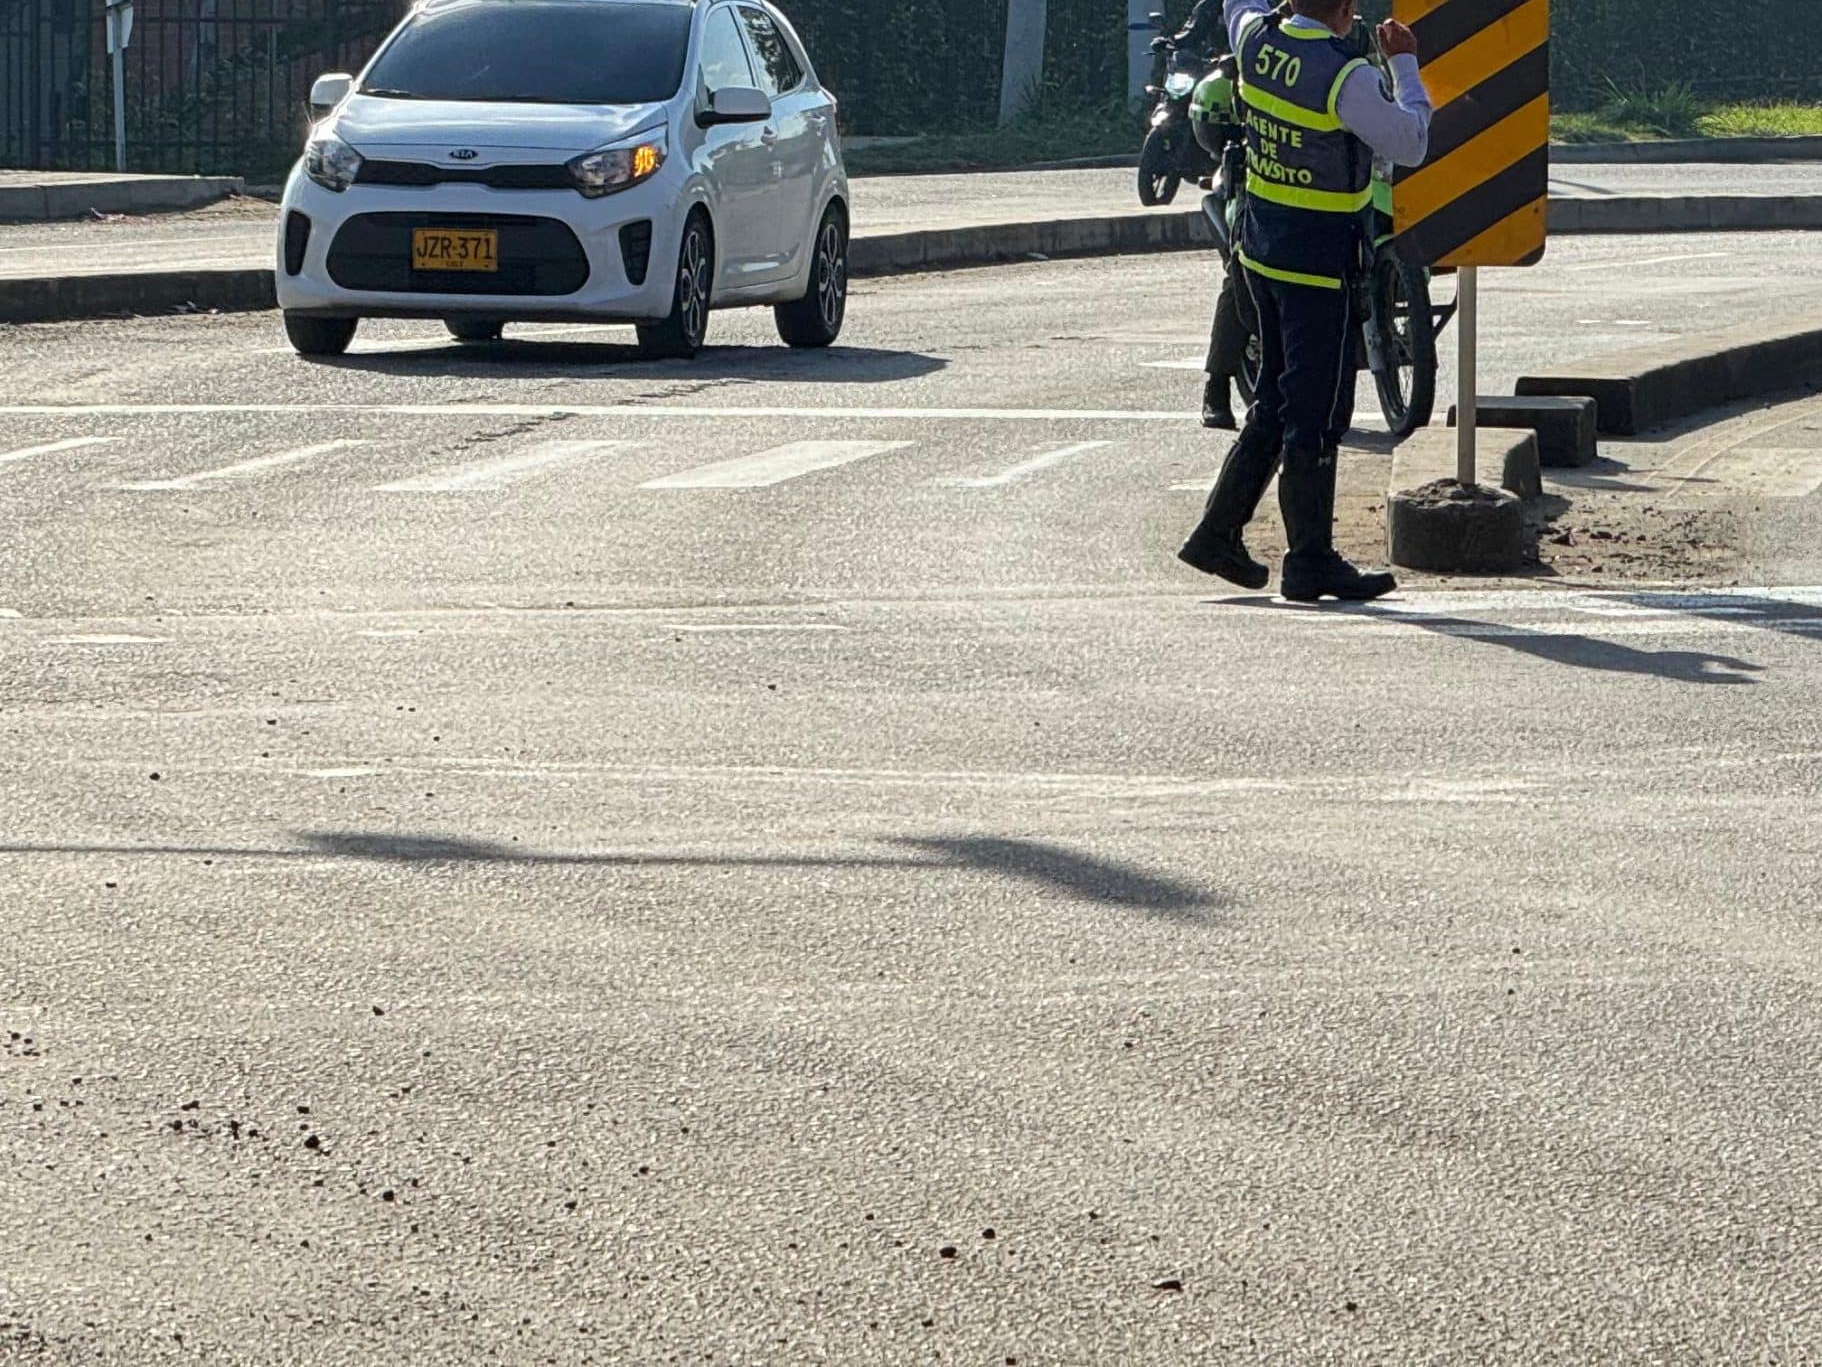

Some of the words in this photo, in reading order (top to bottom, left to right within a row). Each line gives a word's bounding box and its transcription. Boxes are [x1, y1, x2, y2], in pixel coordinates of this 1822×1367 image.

[1255, 43, 1301, 87] 570
[1246, 109, 1303, 148] AGENTE
[1260, 137, 1278, 160] DE
